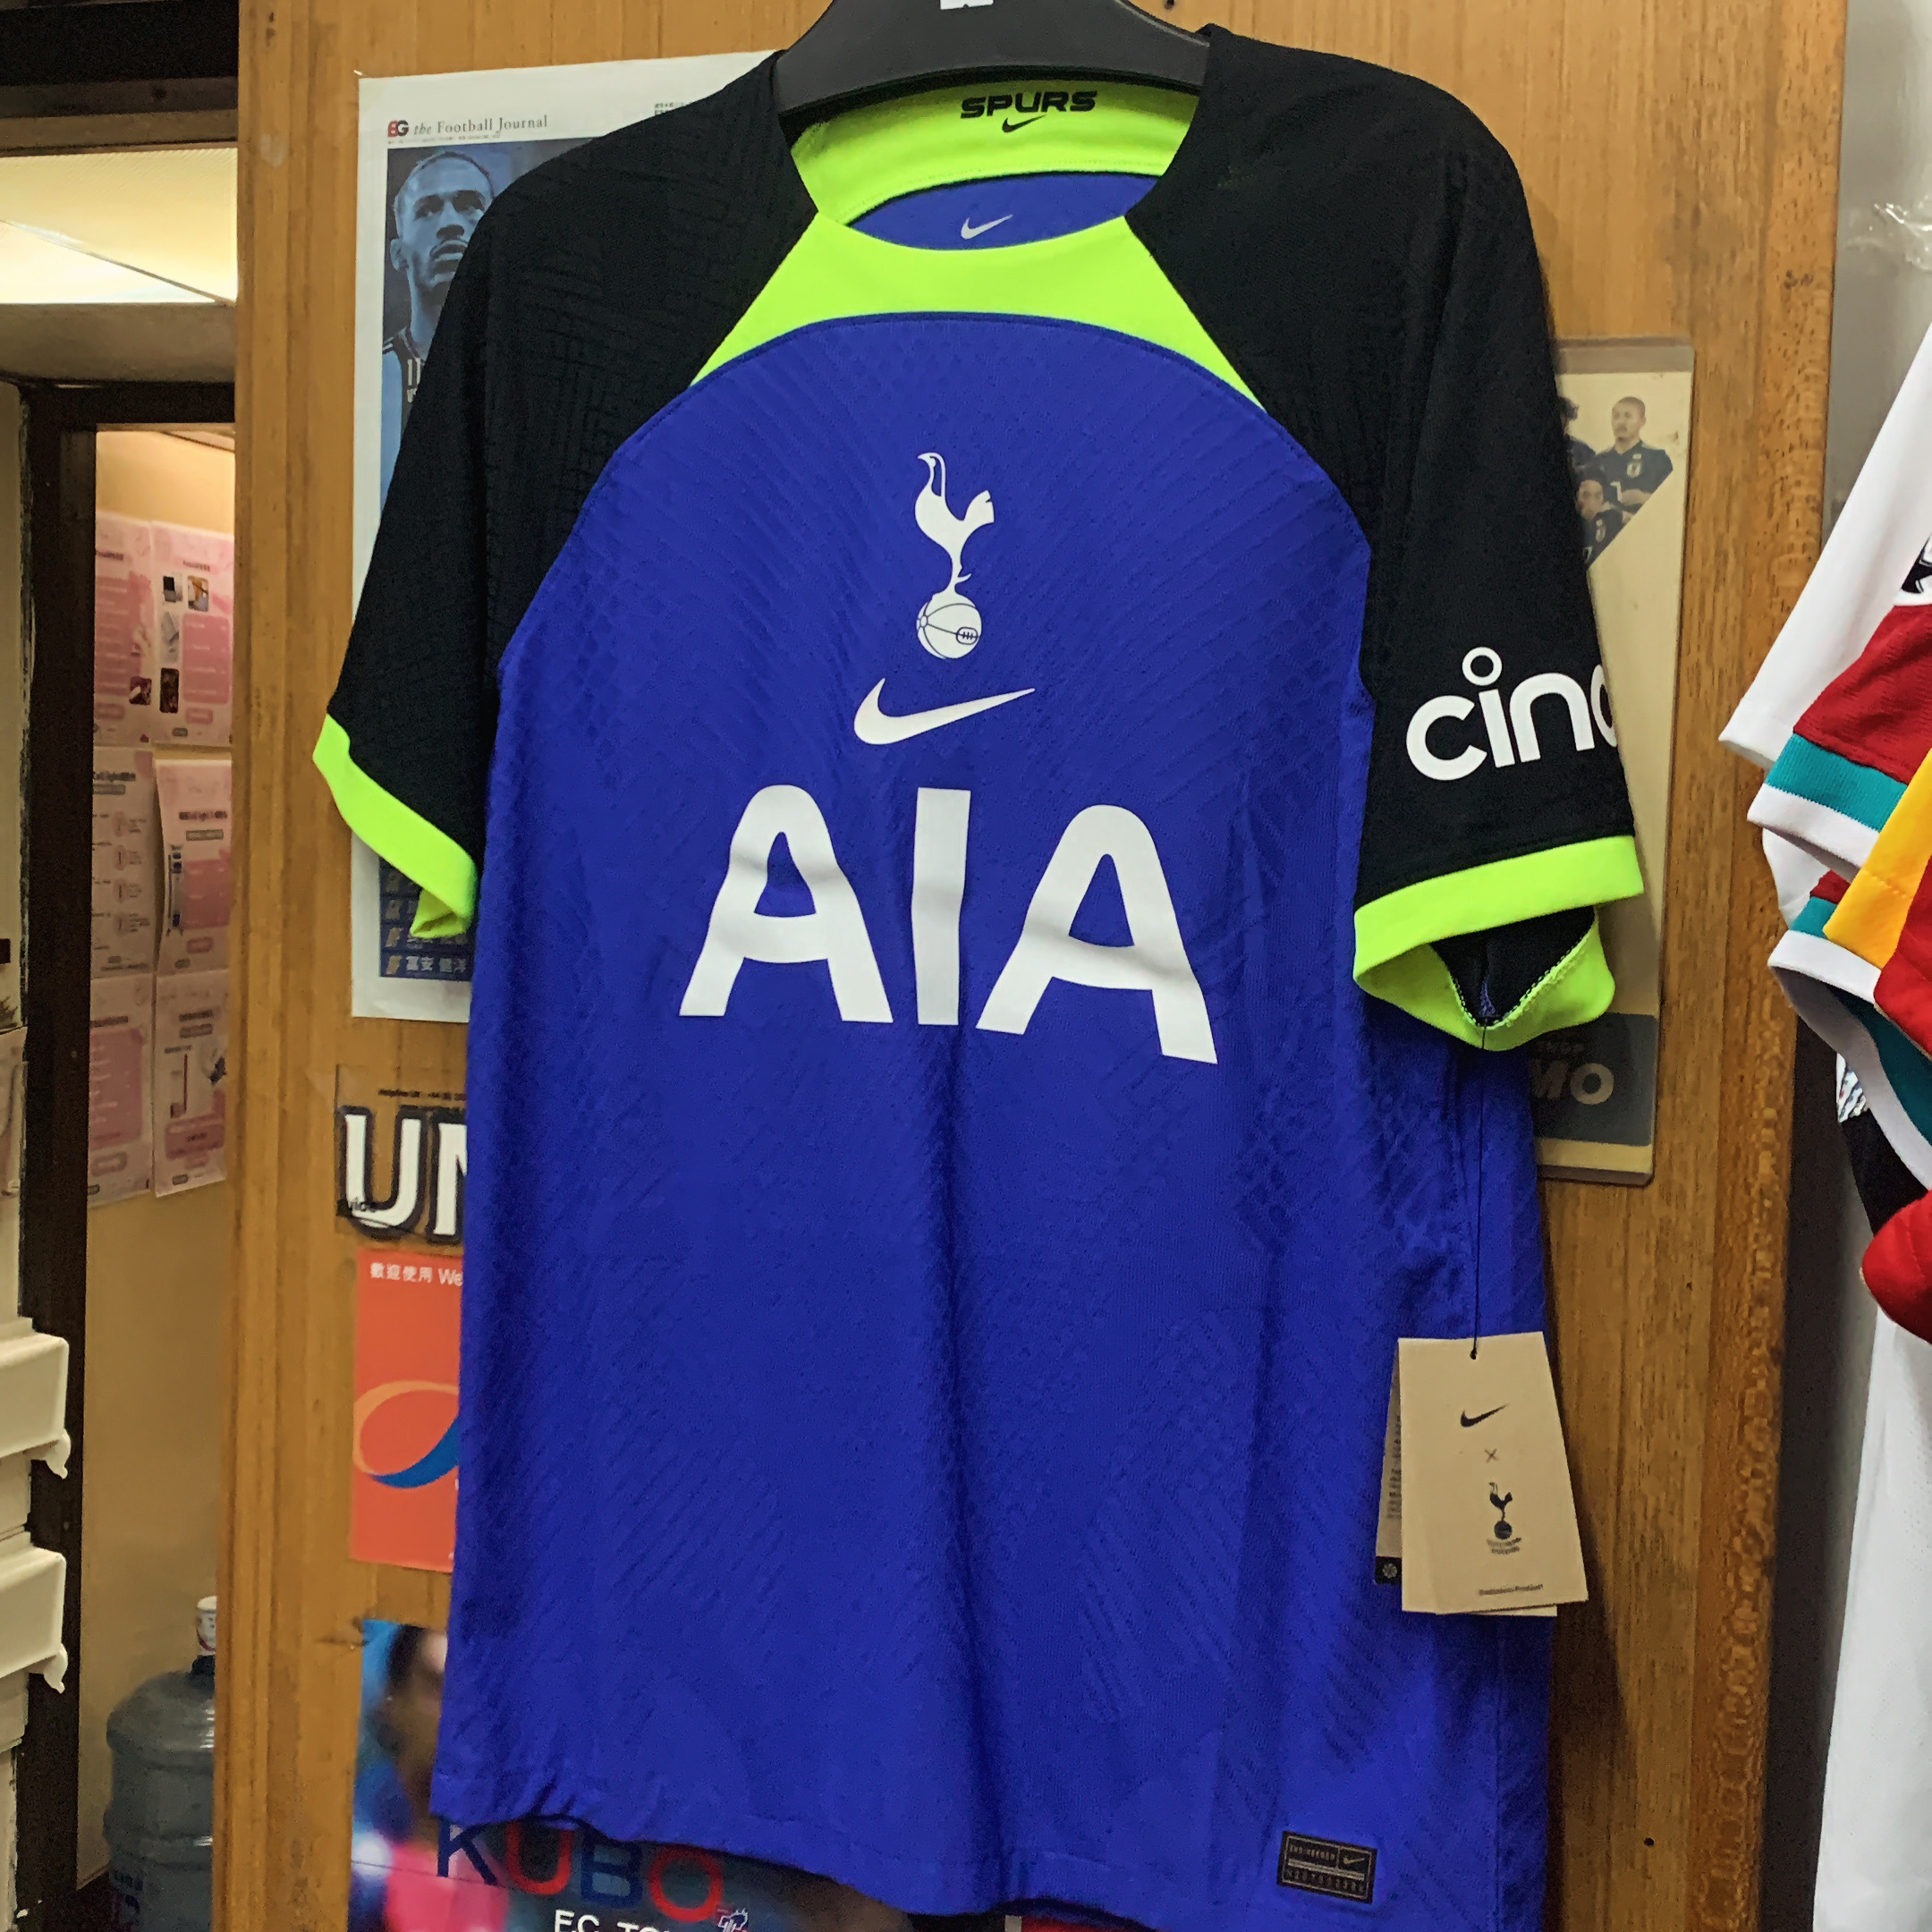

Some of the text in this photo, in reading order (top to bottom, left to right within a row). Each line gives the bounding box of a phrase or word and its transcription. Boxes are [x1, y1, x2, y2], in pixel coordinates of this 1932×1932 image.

[413, 122, 432, 135] the
[436, 118, 493, 134] Football
[495, 114, 548, 134] Journal
[960, 90, 1098, 119] SPURS
[679, 784, 1218, 1064] AIA
[437, 1816, 724, 1922] KUBO
